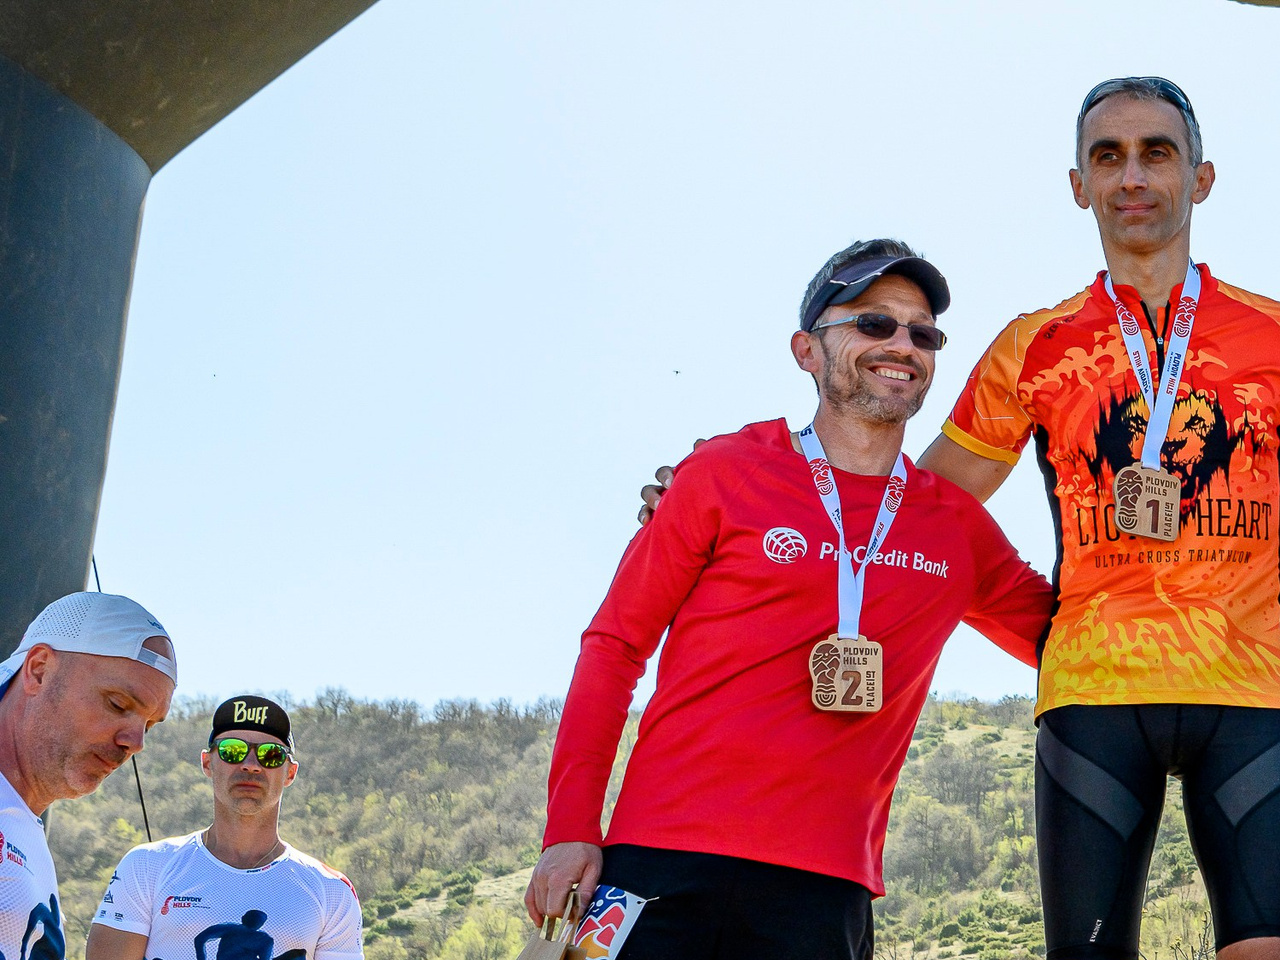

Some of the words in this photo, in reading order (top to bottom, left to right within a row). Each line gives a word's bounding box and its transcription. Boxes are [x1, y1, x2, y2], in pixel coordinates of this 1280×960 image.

[1145, 476, 1178, 490] PLOVDIV
[1145, 485, 1168, 497] HILLS
[1146, 498, 1160, 534] 1
[1196, 498, 1272, 541] HEART
[912, 551, 949, 579] Bank
[1095, 553, 1131, 568] ULTRA
[1138, 550, 1180, 564] CROSS
[843, 647, 879, 656] PLOVDIV
[843, 656, 868, 666] HILLS
[841, 670, 863, 705] 2
[233, 700, 269, 725] Buff
